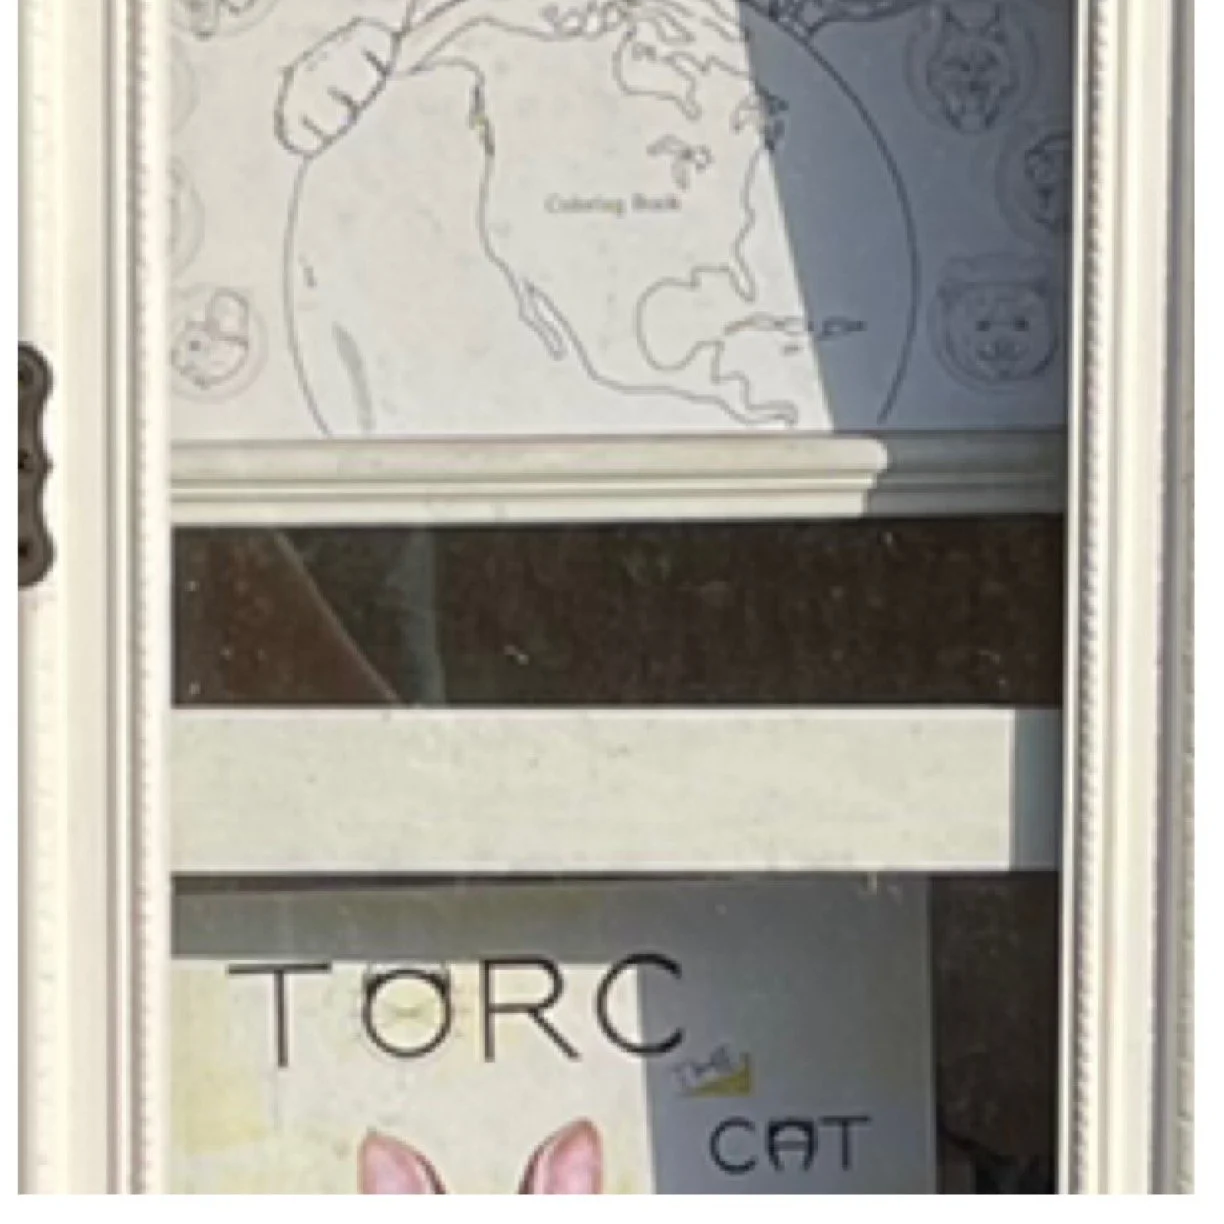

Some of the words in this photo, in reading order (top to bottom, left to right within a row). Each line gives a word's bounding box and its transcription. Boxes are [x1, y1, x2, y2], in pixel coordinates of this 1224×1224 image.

[543, 192, 625, 218] Coloring
[631, 192, 682, 211] Book
[227, 952, 687, 1068] TORC
[710, 1116, 872, 1175] CAT
